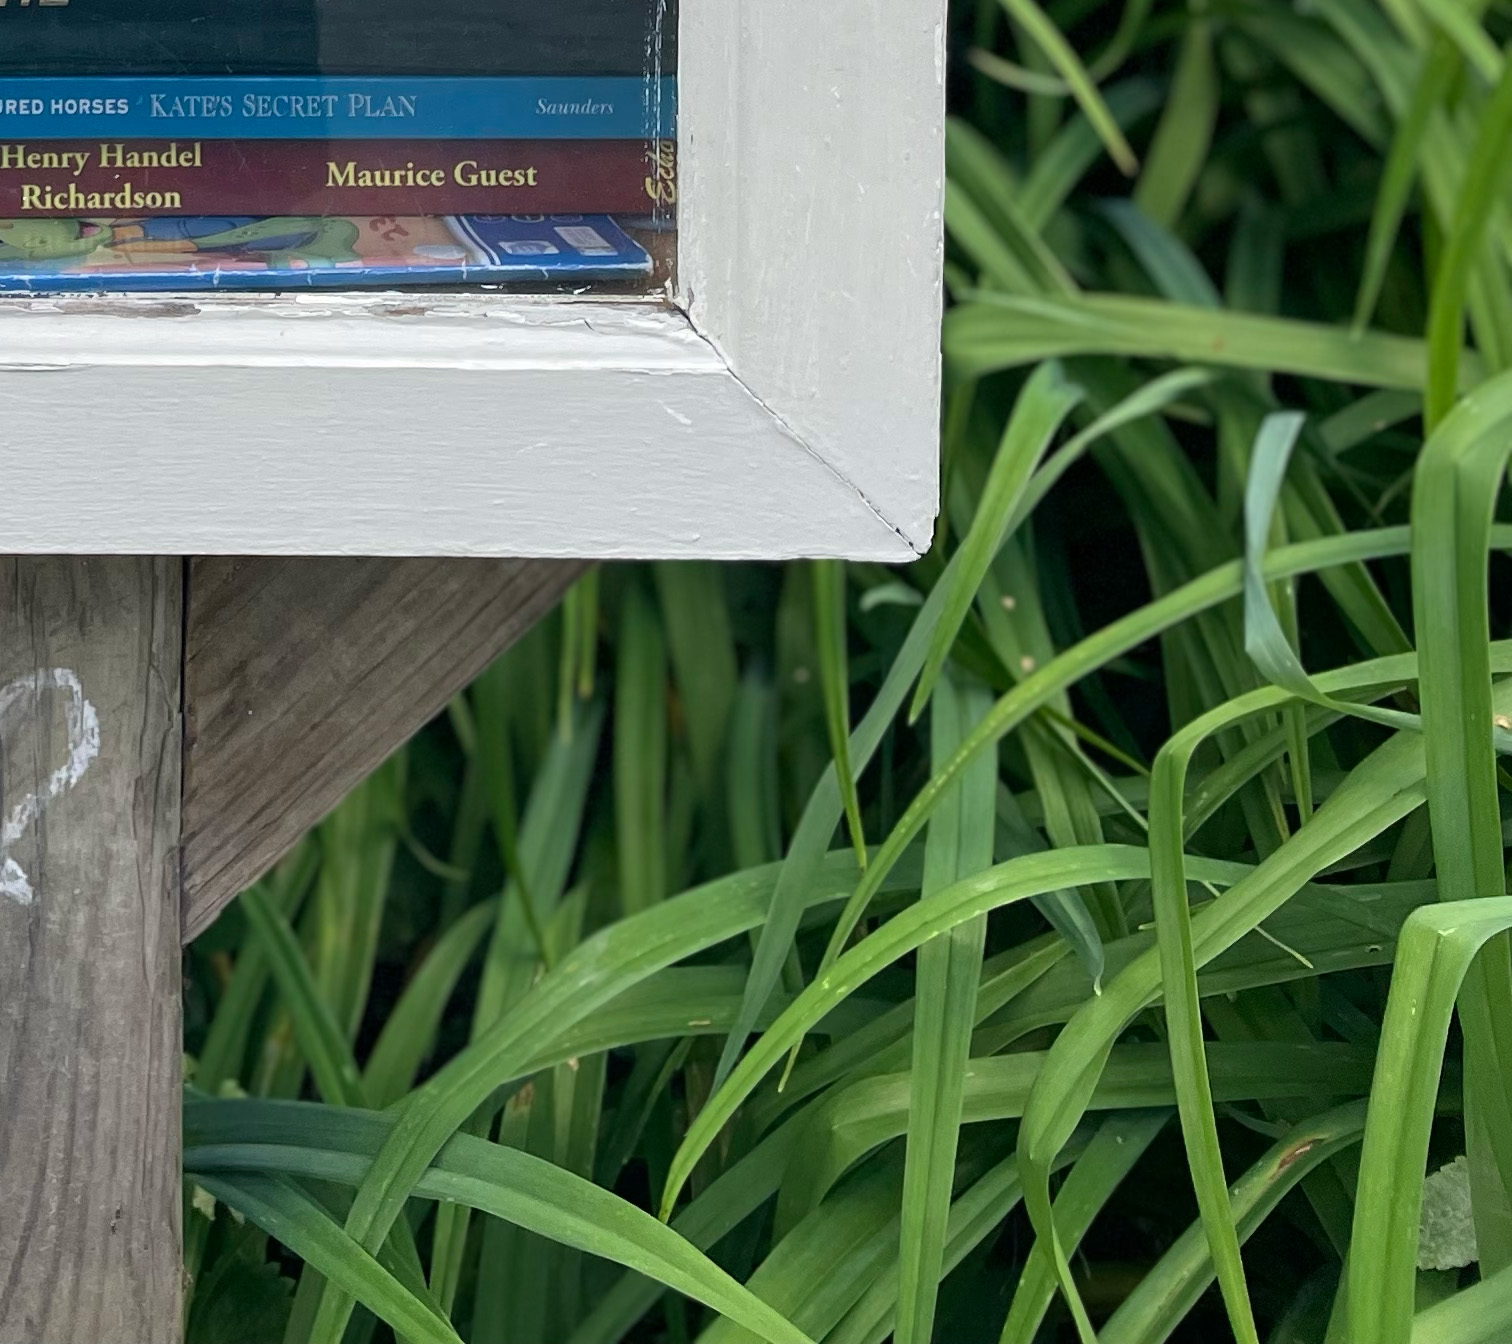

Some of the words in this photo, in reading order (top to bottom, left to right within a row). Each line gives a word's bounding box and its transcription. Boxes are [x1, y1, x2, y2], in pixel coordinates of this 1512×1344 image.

[49, 98, 130, 115] HORSES
[149, 93, 234, 118] KATE'S
[241, 92, 339, 119] SECRET
[347, 92, 417, 118] PLAN
[534, 97, 616, 116] Saunders
[0, 144, 91, 176] Henry
[98, 142, 203, 168] Handel
[325, 161, 446, 188] Maurice
[453, 160, 538, 188] Guest
[20, 182, 182, 210] Richardson
